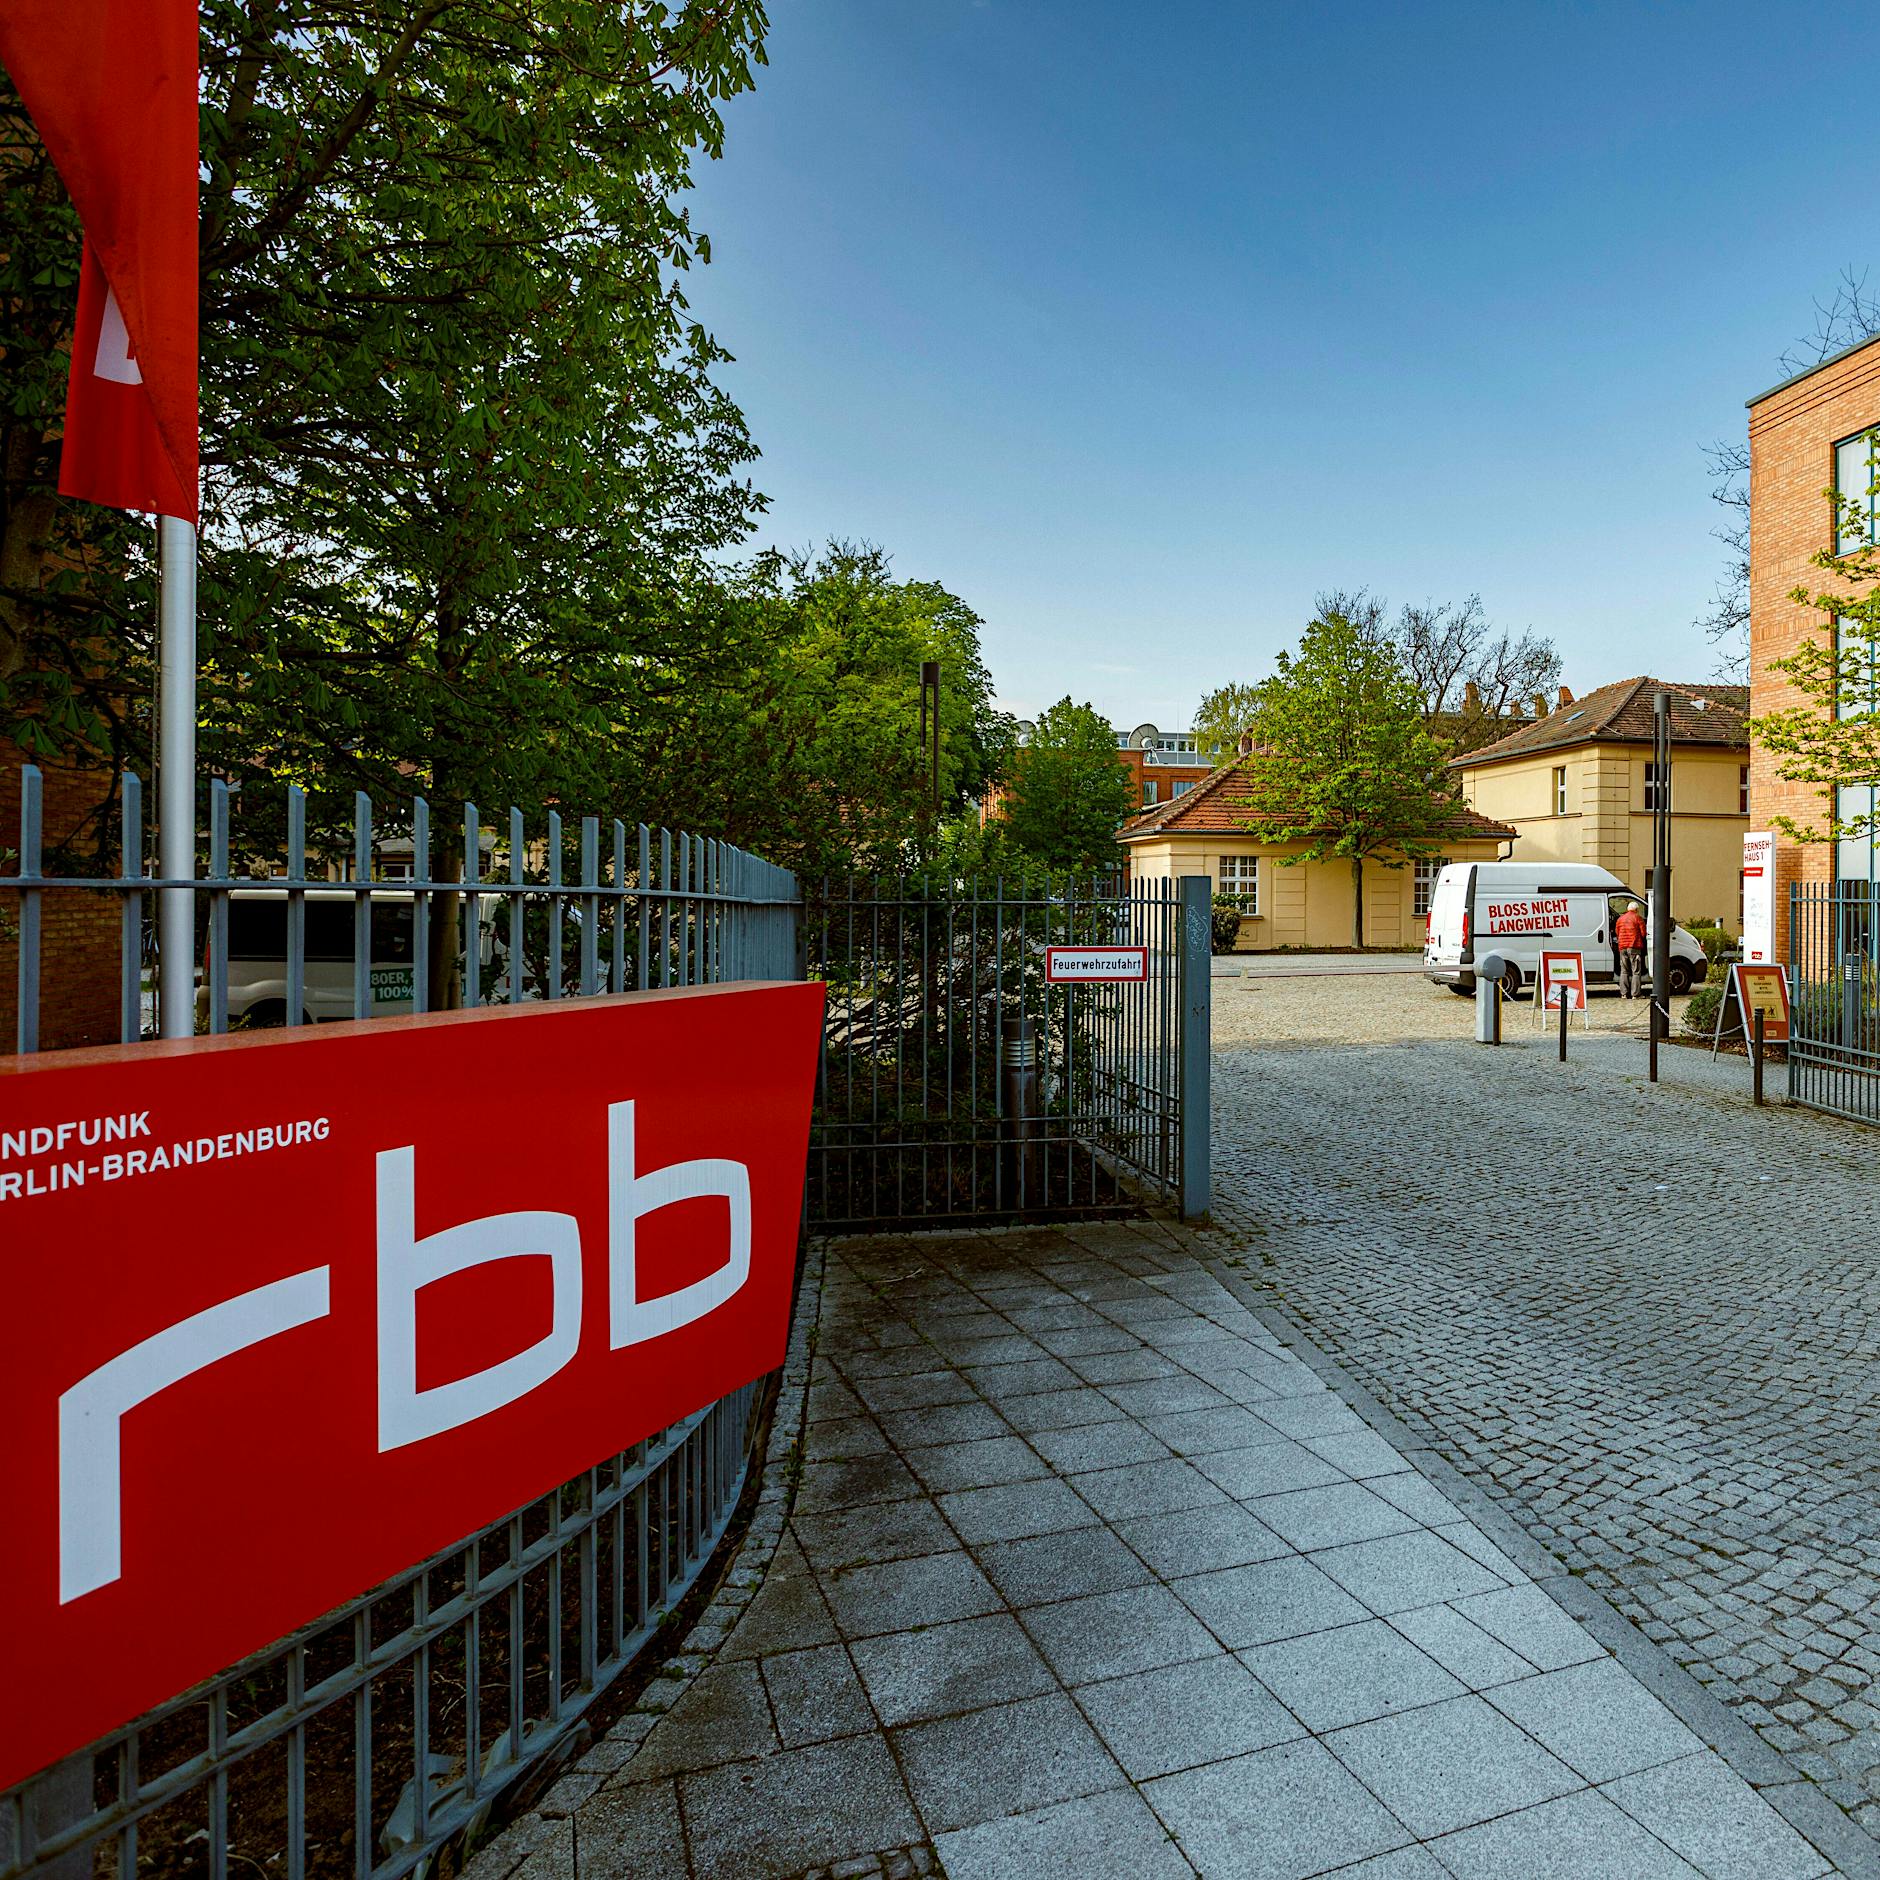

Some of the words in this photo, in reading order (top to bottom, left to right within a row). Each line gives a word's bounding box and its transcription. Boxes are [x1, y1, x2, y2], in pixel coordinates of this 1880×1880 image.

[1744, 840, 1772, 852] FERNSEH-
[1744, 851, 1760, 862] HAUS
[1488, 902, 1528, 918] BLOSS
[1531, 898, 1568, 915] NICHT
[1490, 914, 1570, 934] LANGWEILEN
[1053, 958, 1141, 970] Feuerwehrzufahrt
[377, 986, 415, 999] 100%
[59, 1099, 751, 1605] rbb
